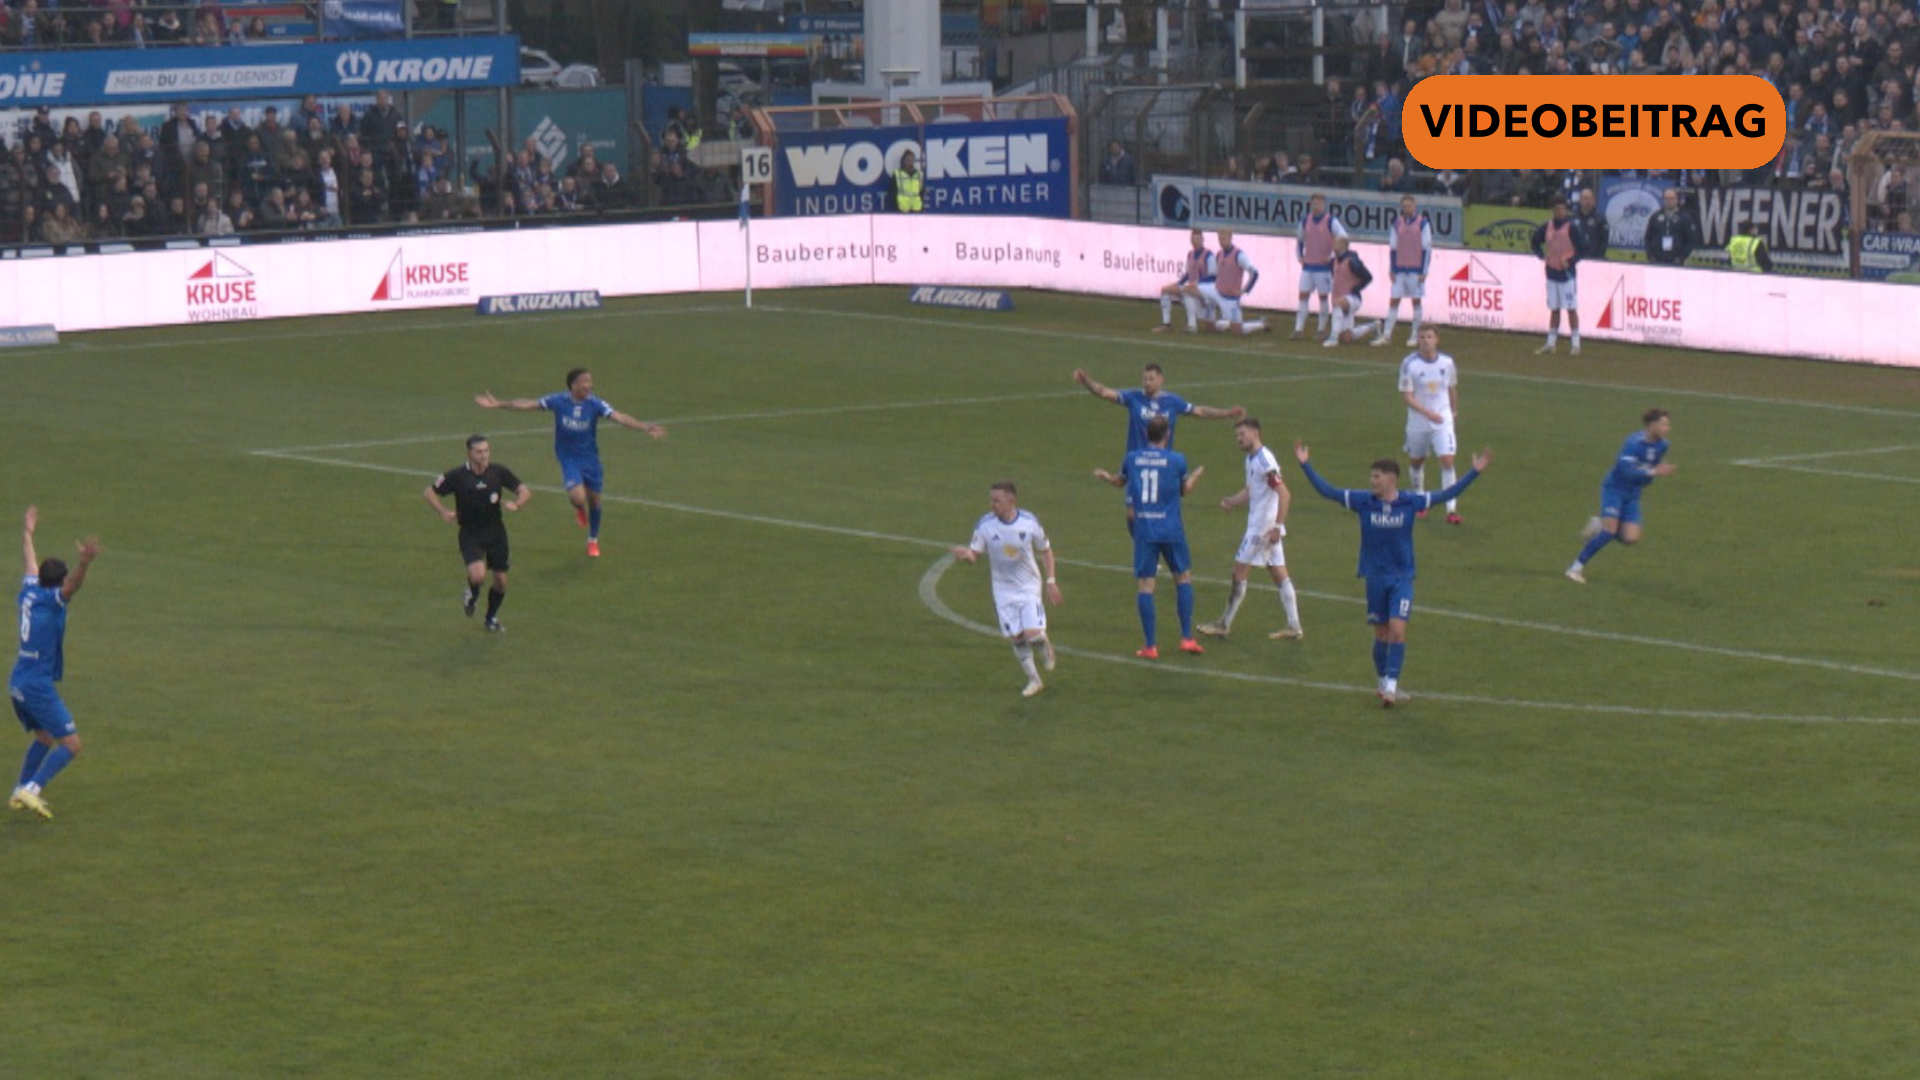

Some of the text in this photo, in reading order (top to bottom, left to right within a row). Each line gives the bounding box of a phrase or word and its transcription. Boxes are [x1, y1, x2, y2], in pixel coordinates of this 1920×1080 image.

[113, 75, 155, 88] MEHR
[157, 73, 178, 87] DU
[181, 73, 207, 86] ALS
[209, 71, 230, 85] DU
[374, 55, 495, 83] KRONE
[745, 153, 770, 178] 16
[1198, 193, 1311, 225] REINHAR
[756, 242, 897, 263] Bauberatung
[955, 242, 1061, 267] Bauplanung
[1864, 234, 1889, 251] CAR
[406, 262, 469, 285] KRUSE
[1102, 251, 1186, 276] Bauleitung
[187, 280, 256, 306] KRUSE
[1448, 286, 1503, 311] KRUSE
[188, 307, 258, 321] WOHNBAU
[1449, 312, 1504, 327] WOHNBAU
[1626, 296, 1682, 321] KRUSE
[1140, 469, 1159, 504] 11
